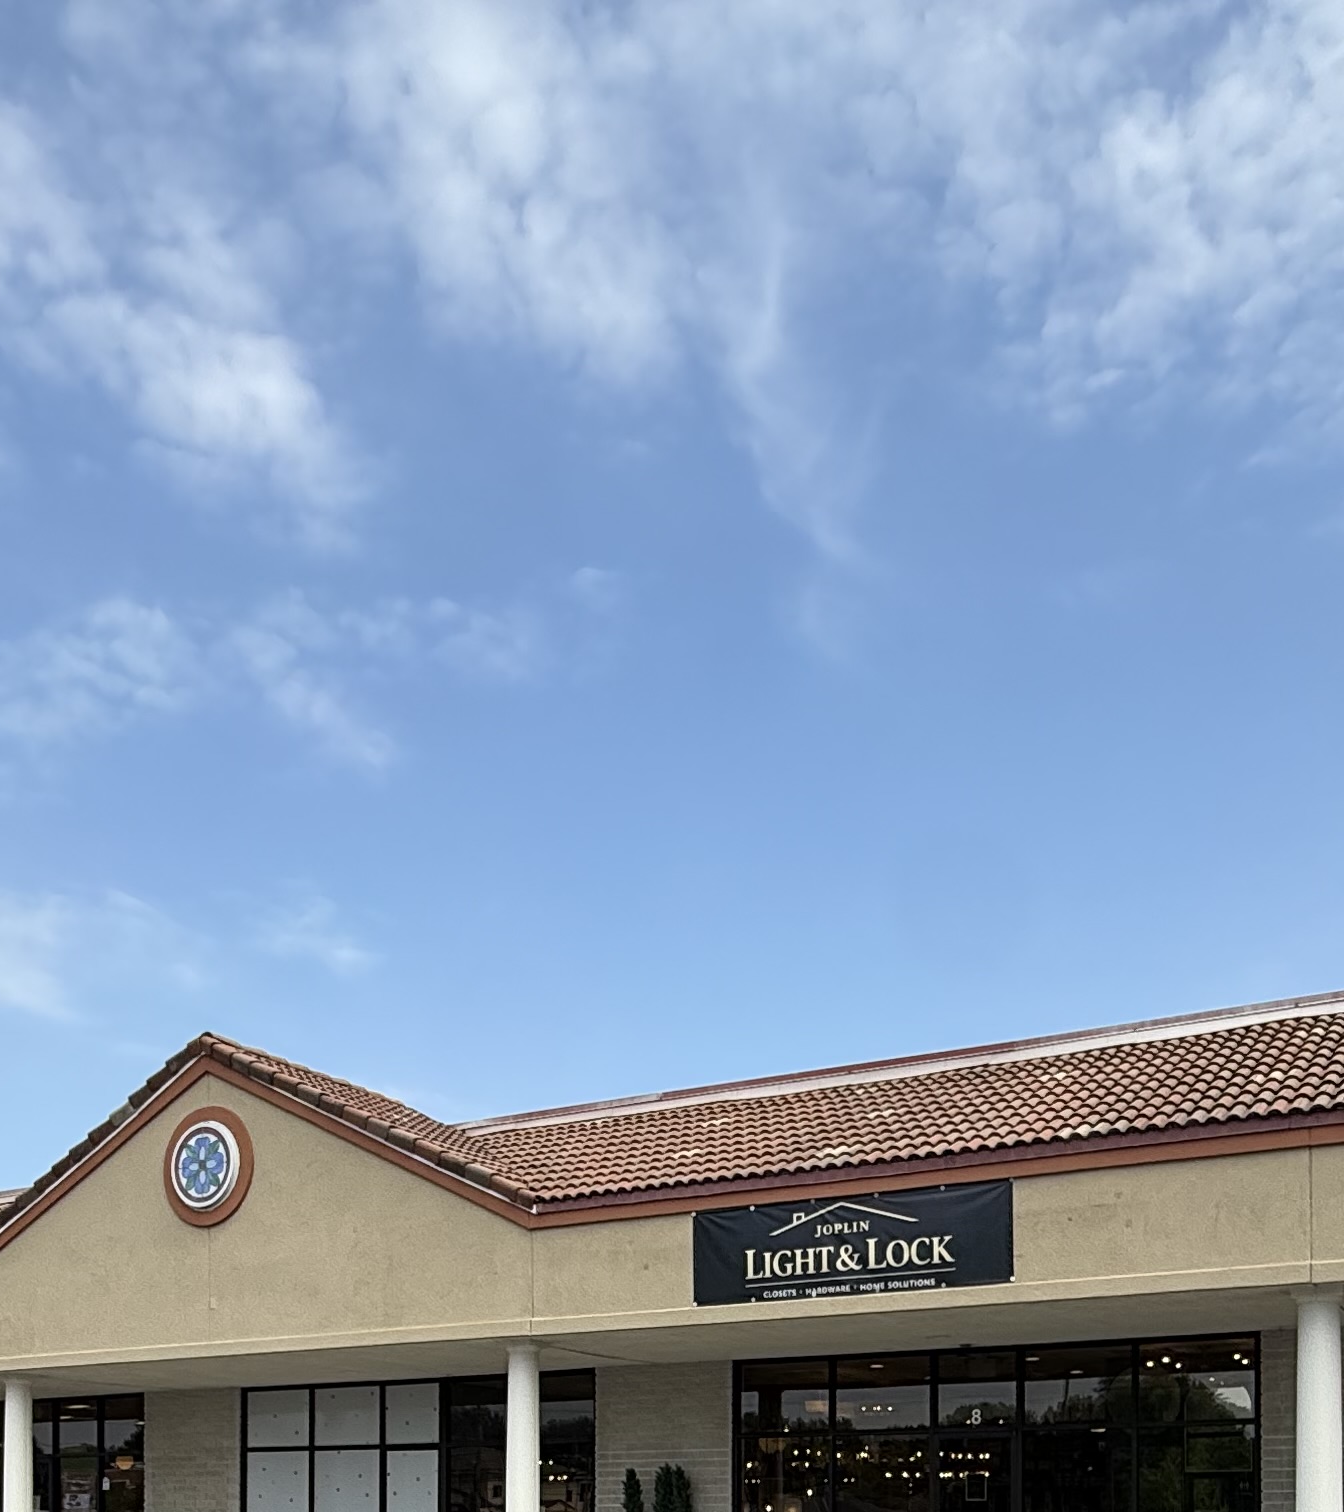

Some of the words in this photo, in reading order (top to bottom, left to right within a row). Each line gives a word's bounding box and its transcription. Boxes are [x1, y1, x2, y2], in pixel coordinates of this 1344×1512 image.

[814, 1220, 870, 1237] JOPLIN
[745, 1246, 835, 1280] LIGHT
[836, 1244, 862, 1271] &
[866, 1235, 956, 1271] LOCK
[763, 1288, 797, 1299] CLOSETS
[806, 1284, 851, 1297] HARDWARE
[860, 1282, 885, 1292] HOME
[887, 1278, 936, 1289] SOLUTIONS
[971, 1408, 982, 1425] 8
